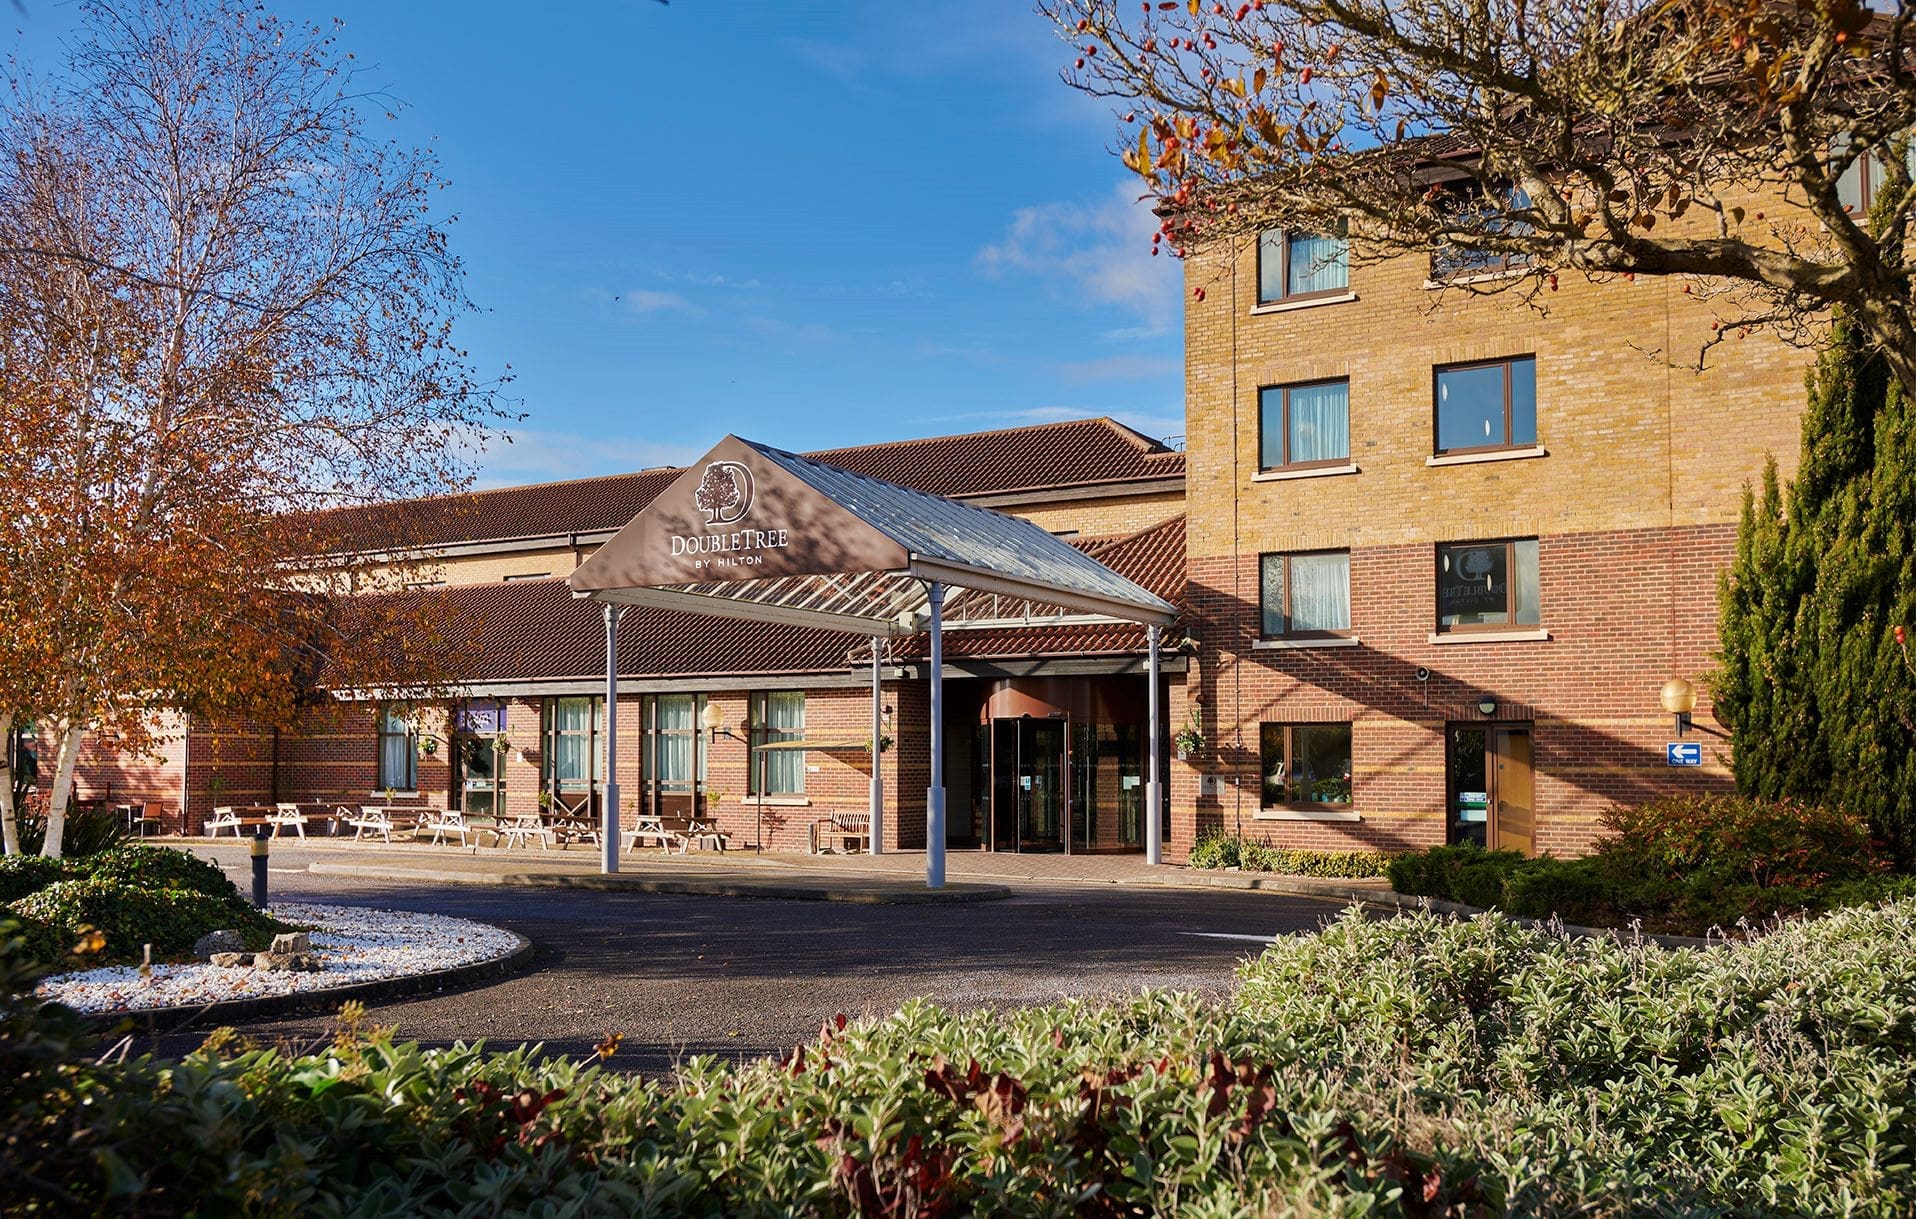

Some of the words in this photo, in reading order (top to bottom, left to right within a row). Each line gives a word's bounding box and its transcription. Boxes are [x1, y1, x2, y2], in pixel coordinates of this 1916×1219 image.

[671, 529, 789, 556] DOUBLETREE
[695, 560, 711, 569] BY
[717, 555, 762, 567] HILTON
